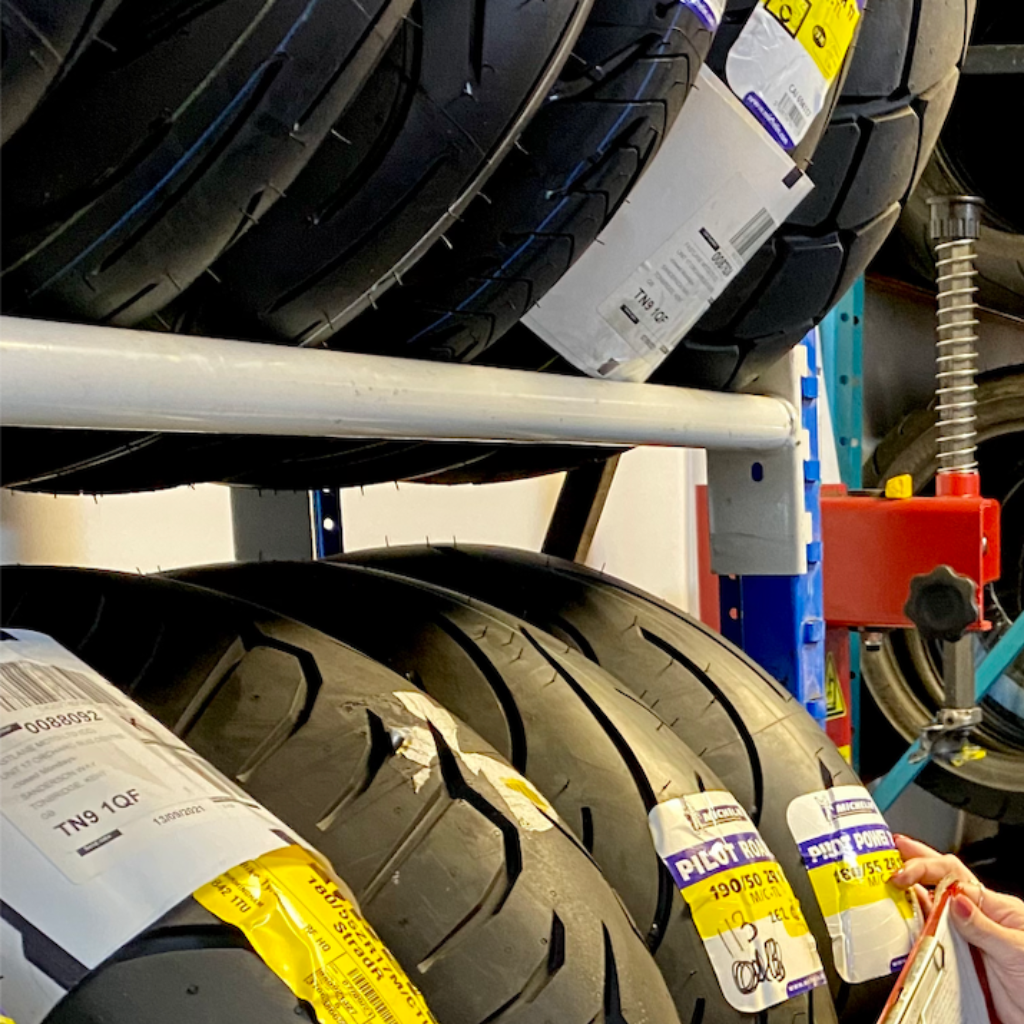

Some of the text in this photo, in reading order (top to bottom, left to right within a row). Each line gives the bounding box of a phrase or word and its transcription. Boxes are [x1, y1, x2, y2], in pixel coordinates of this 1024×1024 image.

[634, 288, 669, 324] TN9 1QF
[25, 710, 102, 734] 0088092
[53, 789, 141, 838] TN9 1QF
[675, 843, 738, 881] PILOT
[710, 870, 762, 900] 190/50
[231, 895, 252, 914] 1TU
